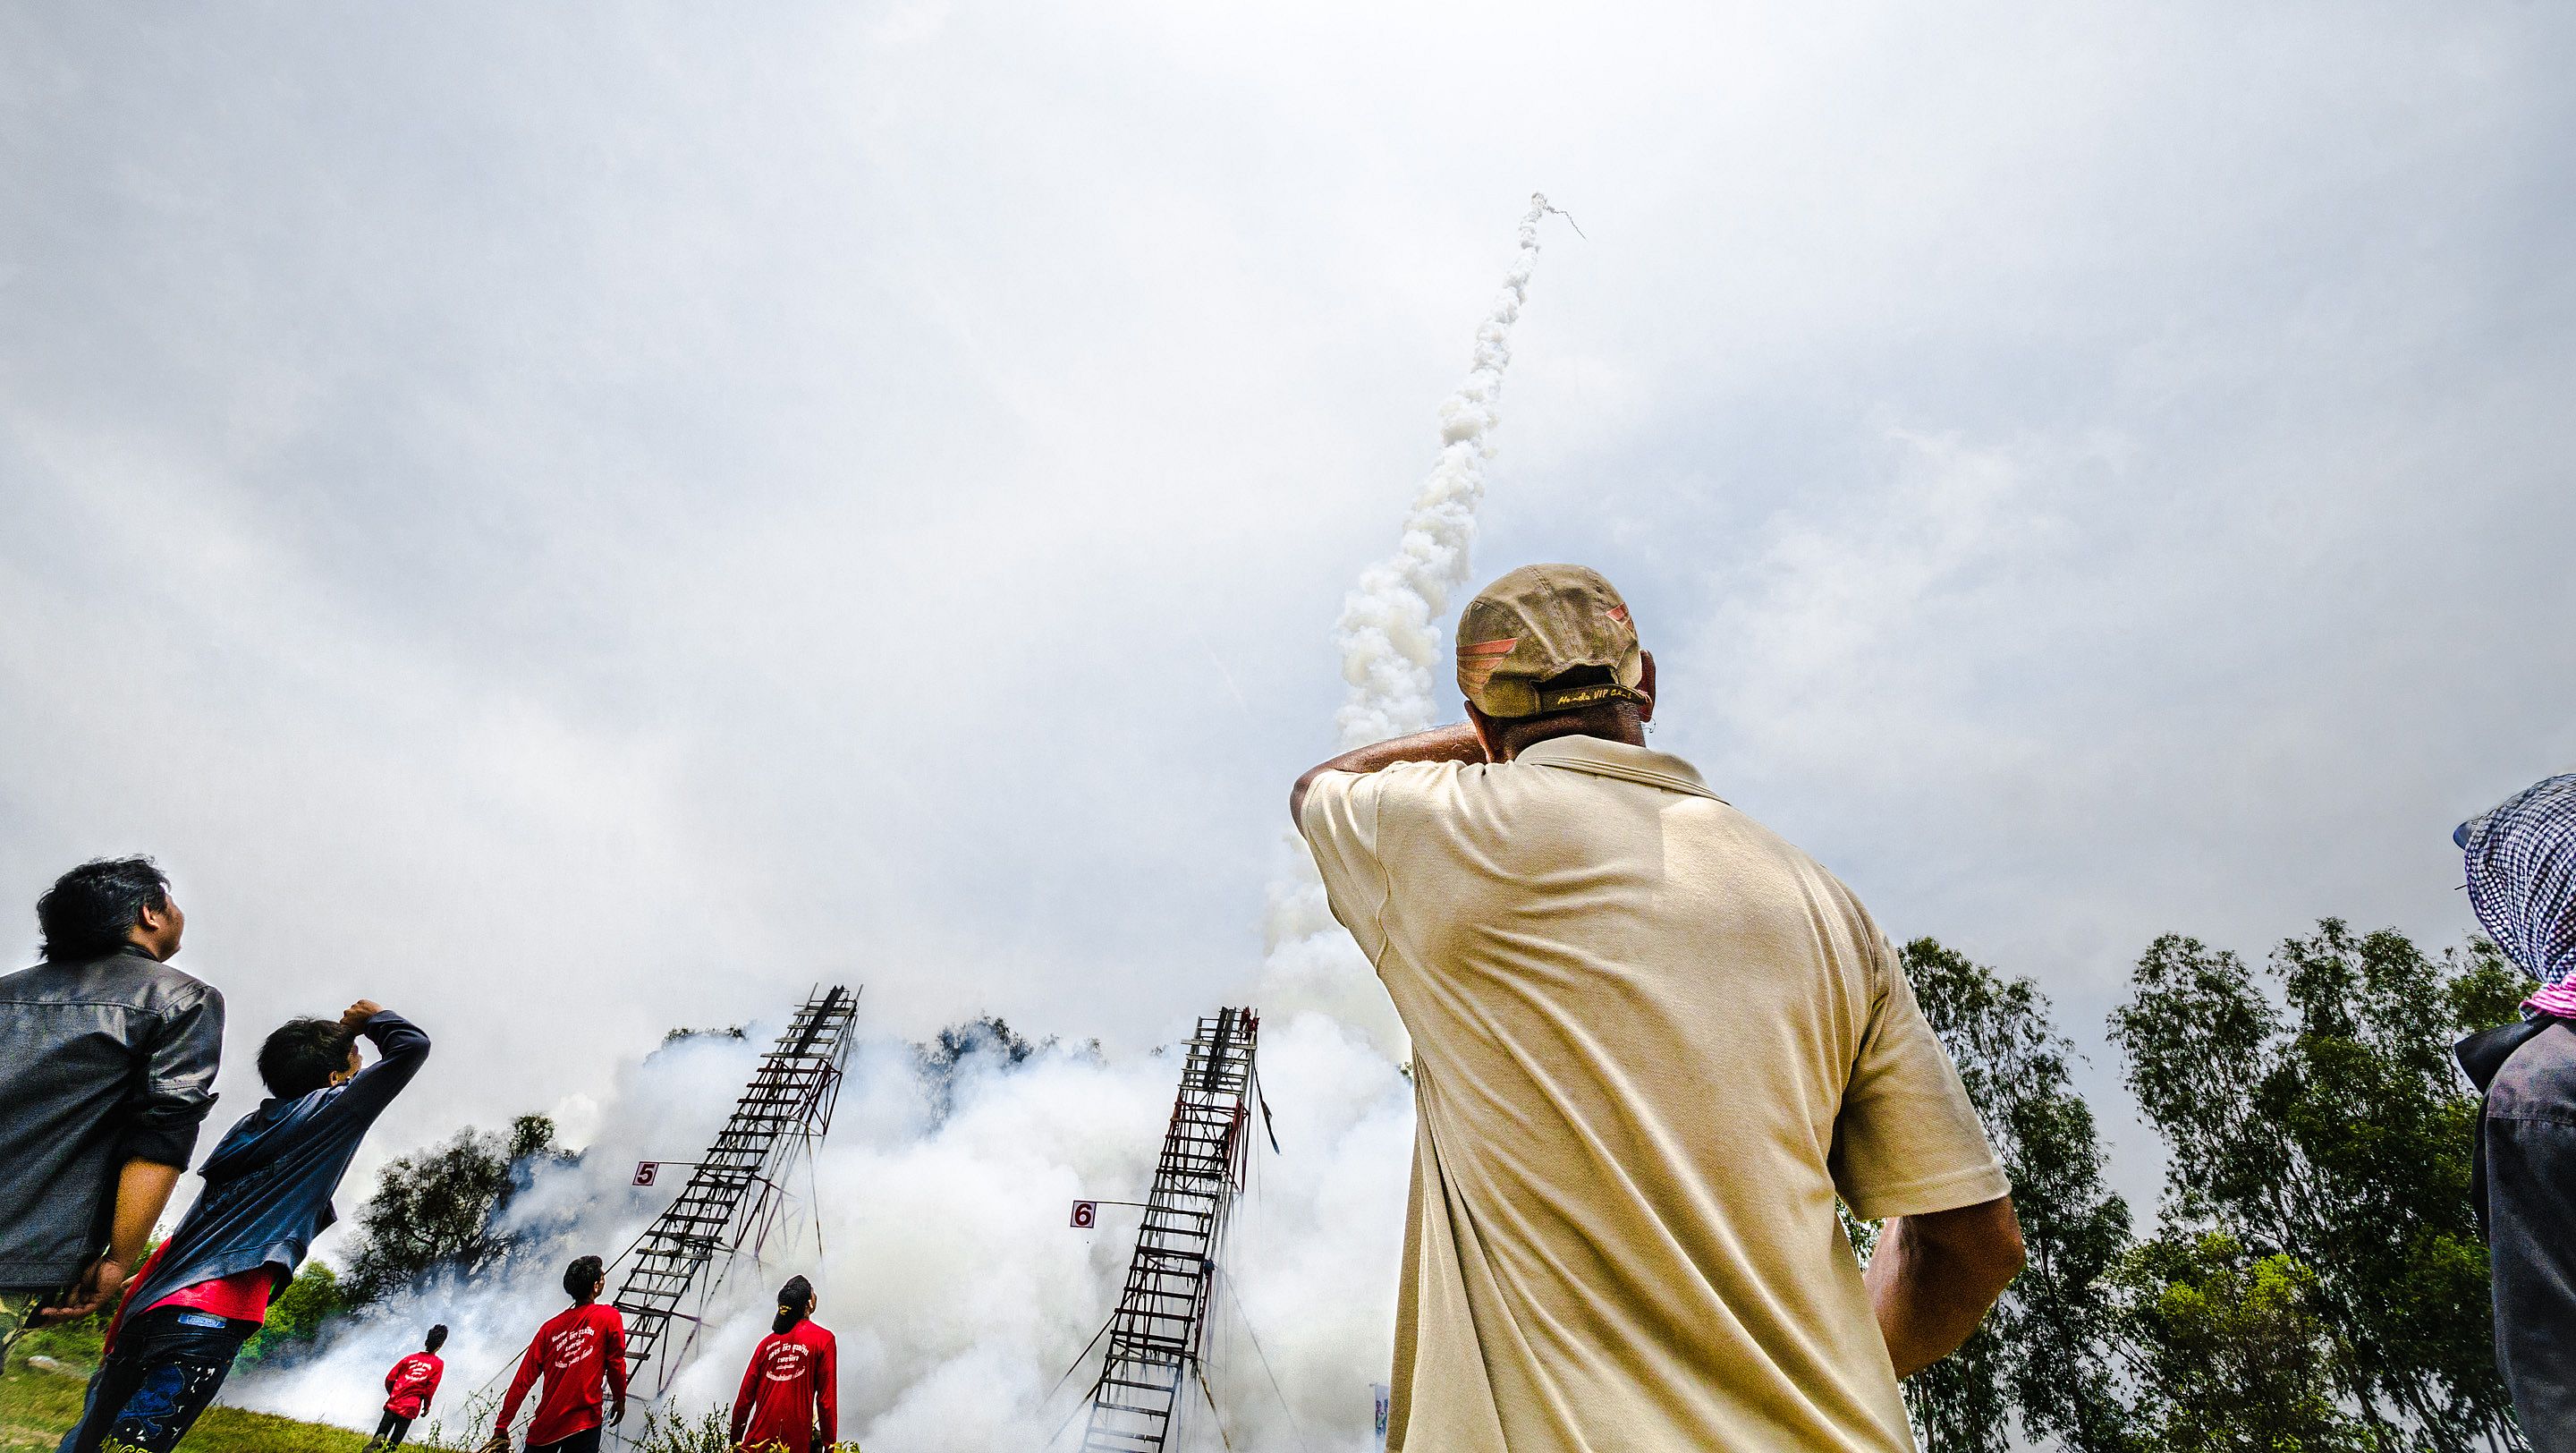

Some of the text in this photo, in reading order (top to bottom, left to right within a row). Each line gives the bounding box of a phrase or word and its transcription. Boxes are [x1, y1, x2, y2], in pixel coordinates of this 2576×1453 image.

[1557, 692, 1590, 704] Honda
[1594, 689, 1608, 699] VIP
[638, 1163, 655, 1184] 5
[1075, 1203, 1092, 1226] 6
